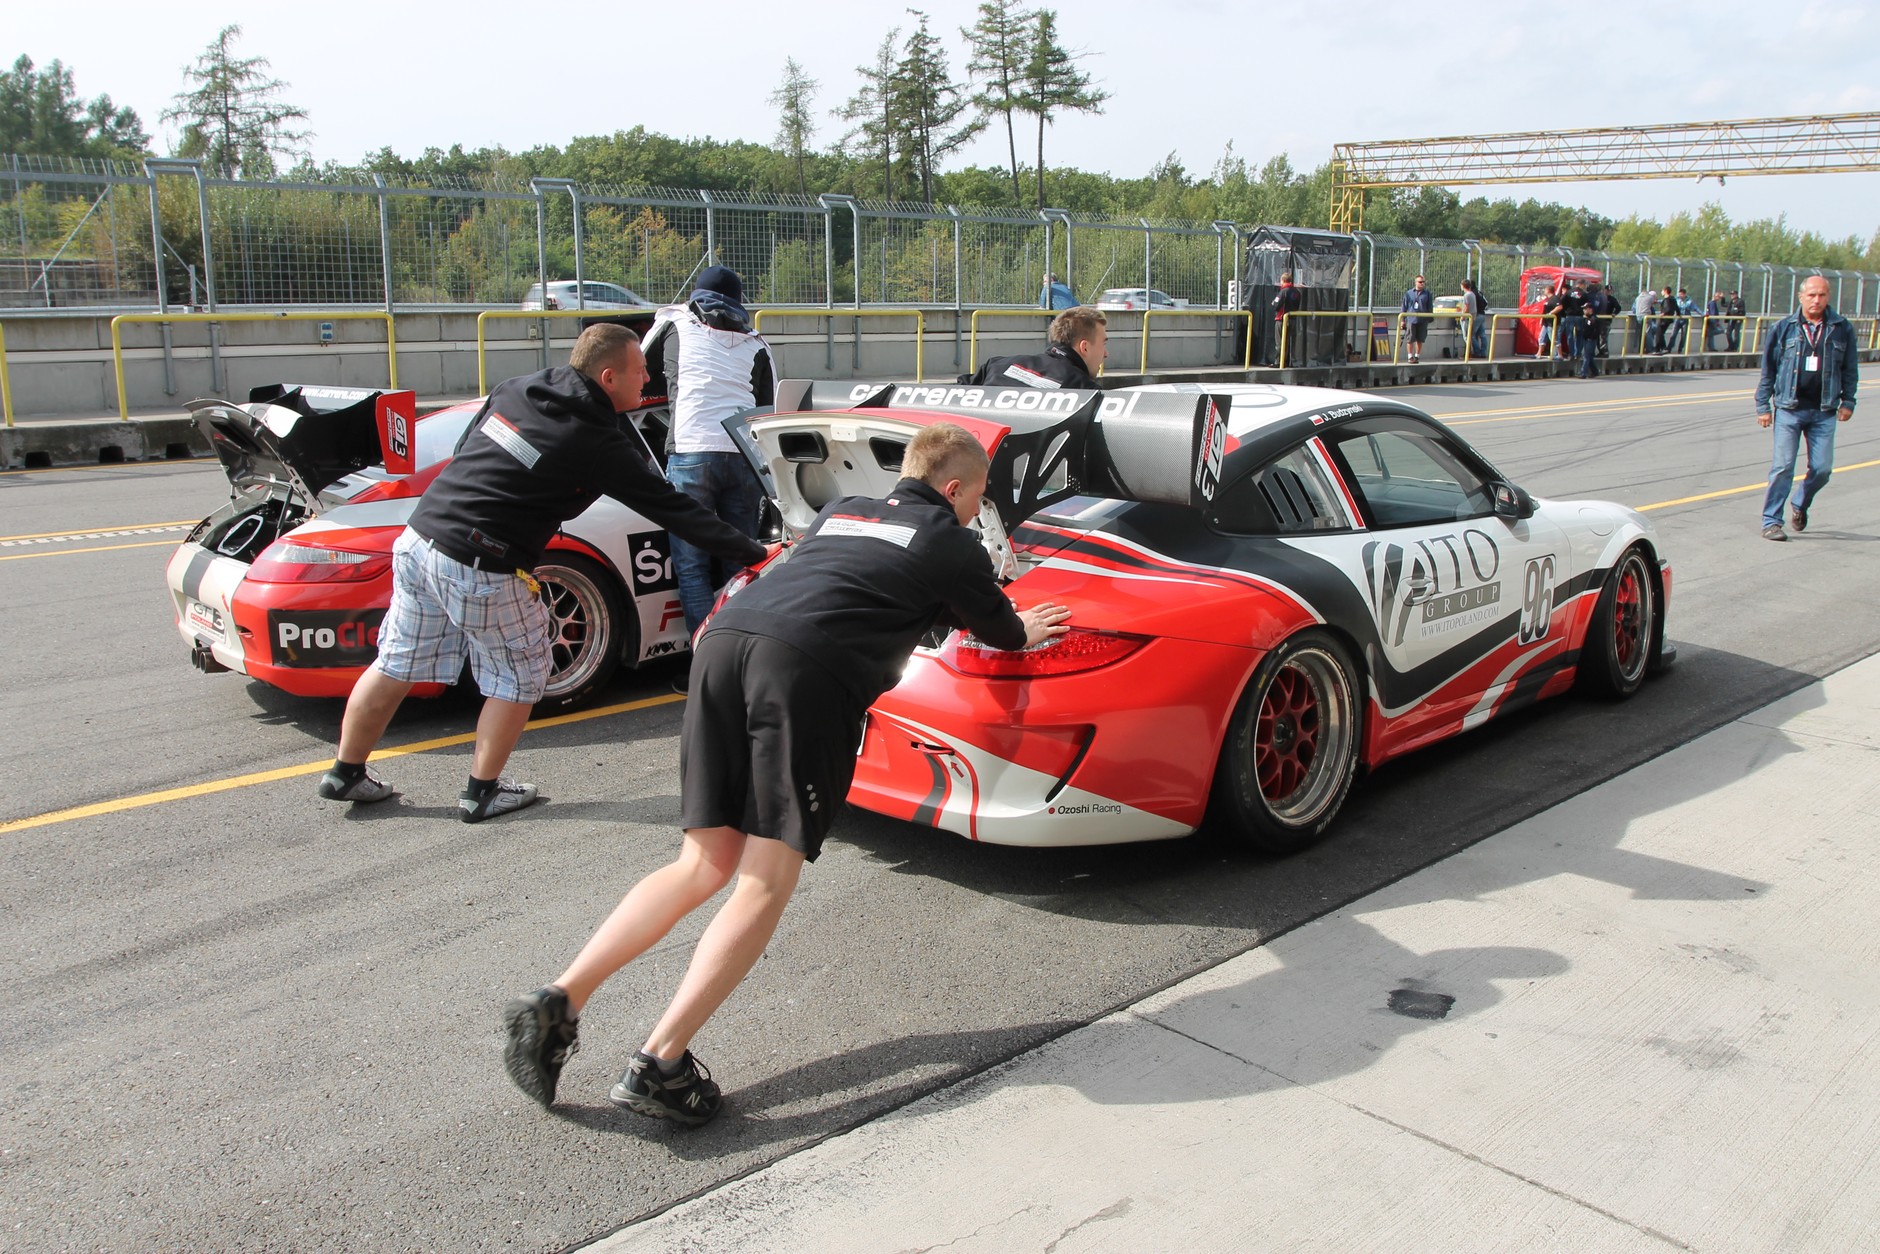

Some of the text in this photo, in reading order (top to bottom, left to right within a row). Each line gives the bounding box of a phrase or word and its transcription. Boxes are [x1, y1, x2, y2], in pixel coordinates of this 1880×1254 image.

[394, 417, 406, 457] GT3
[1425, 584, 1499, 618] GROUP
[1520, 557, 1554, 643] 96
[1421, 605, 1500, 637] WWW.ITOPOLAND.COM
[1058, 803, 1122, 815] Ozoshi Racing
